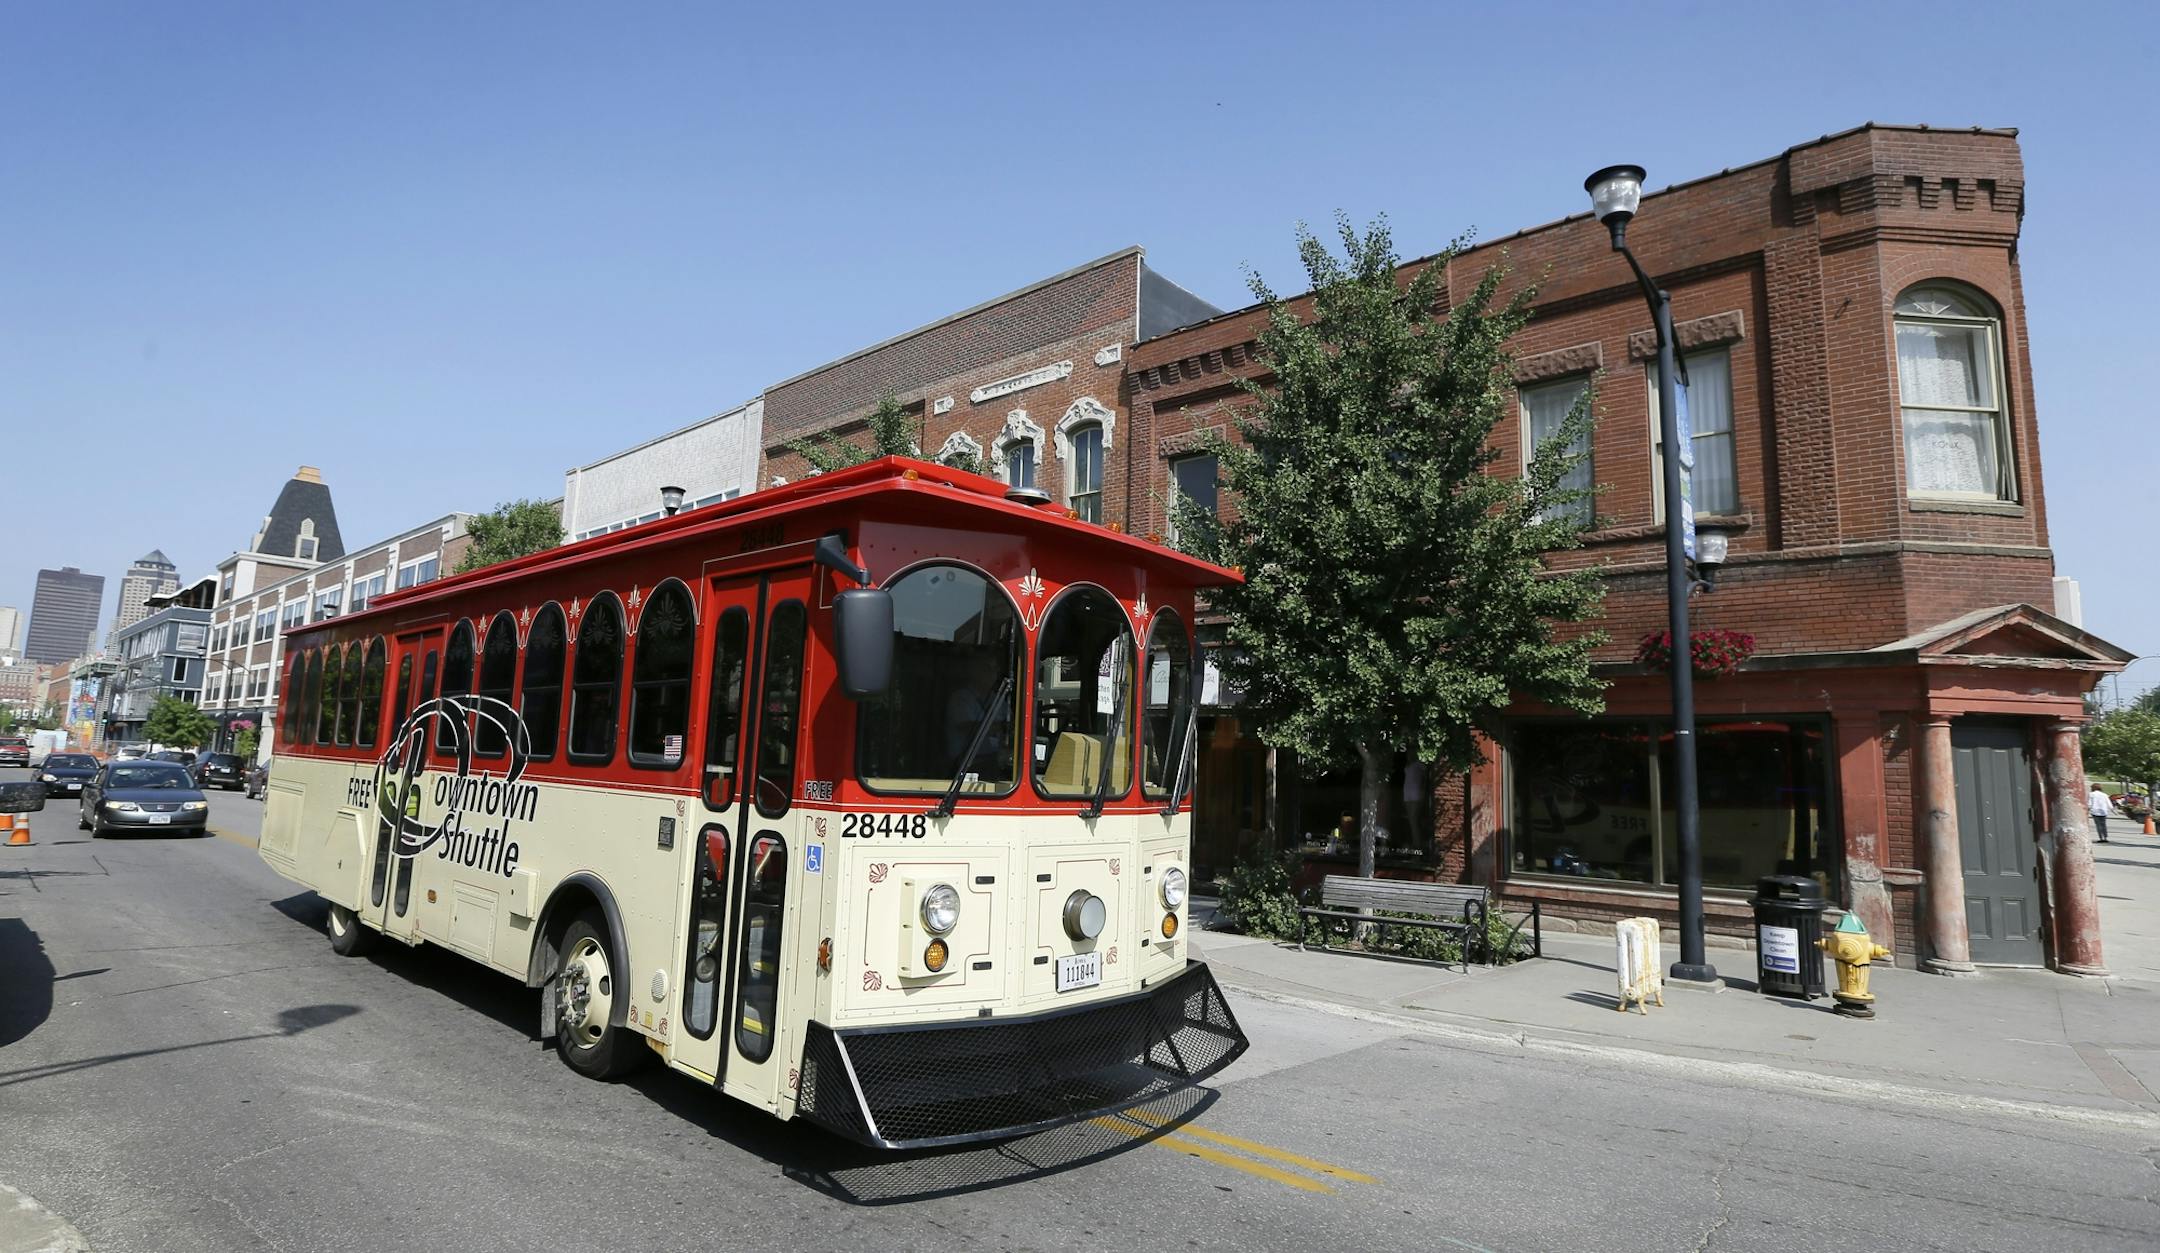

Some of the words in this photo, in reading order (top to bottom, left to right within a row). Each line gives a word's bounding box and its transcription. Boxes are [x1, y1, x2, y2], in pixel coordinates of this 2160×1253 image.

[348, 777, 371, 808] FREE
[804, 780, 832, 800] FREE
[841, 813, 926, 839] 28448
[438, 811, 520, 878] Shuttle
[1066, 962, 1095, 983] 111844
